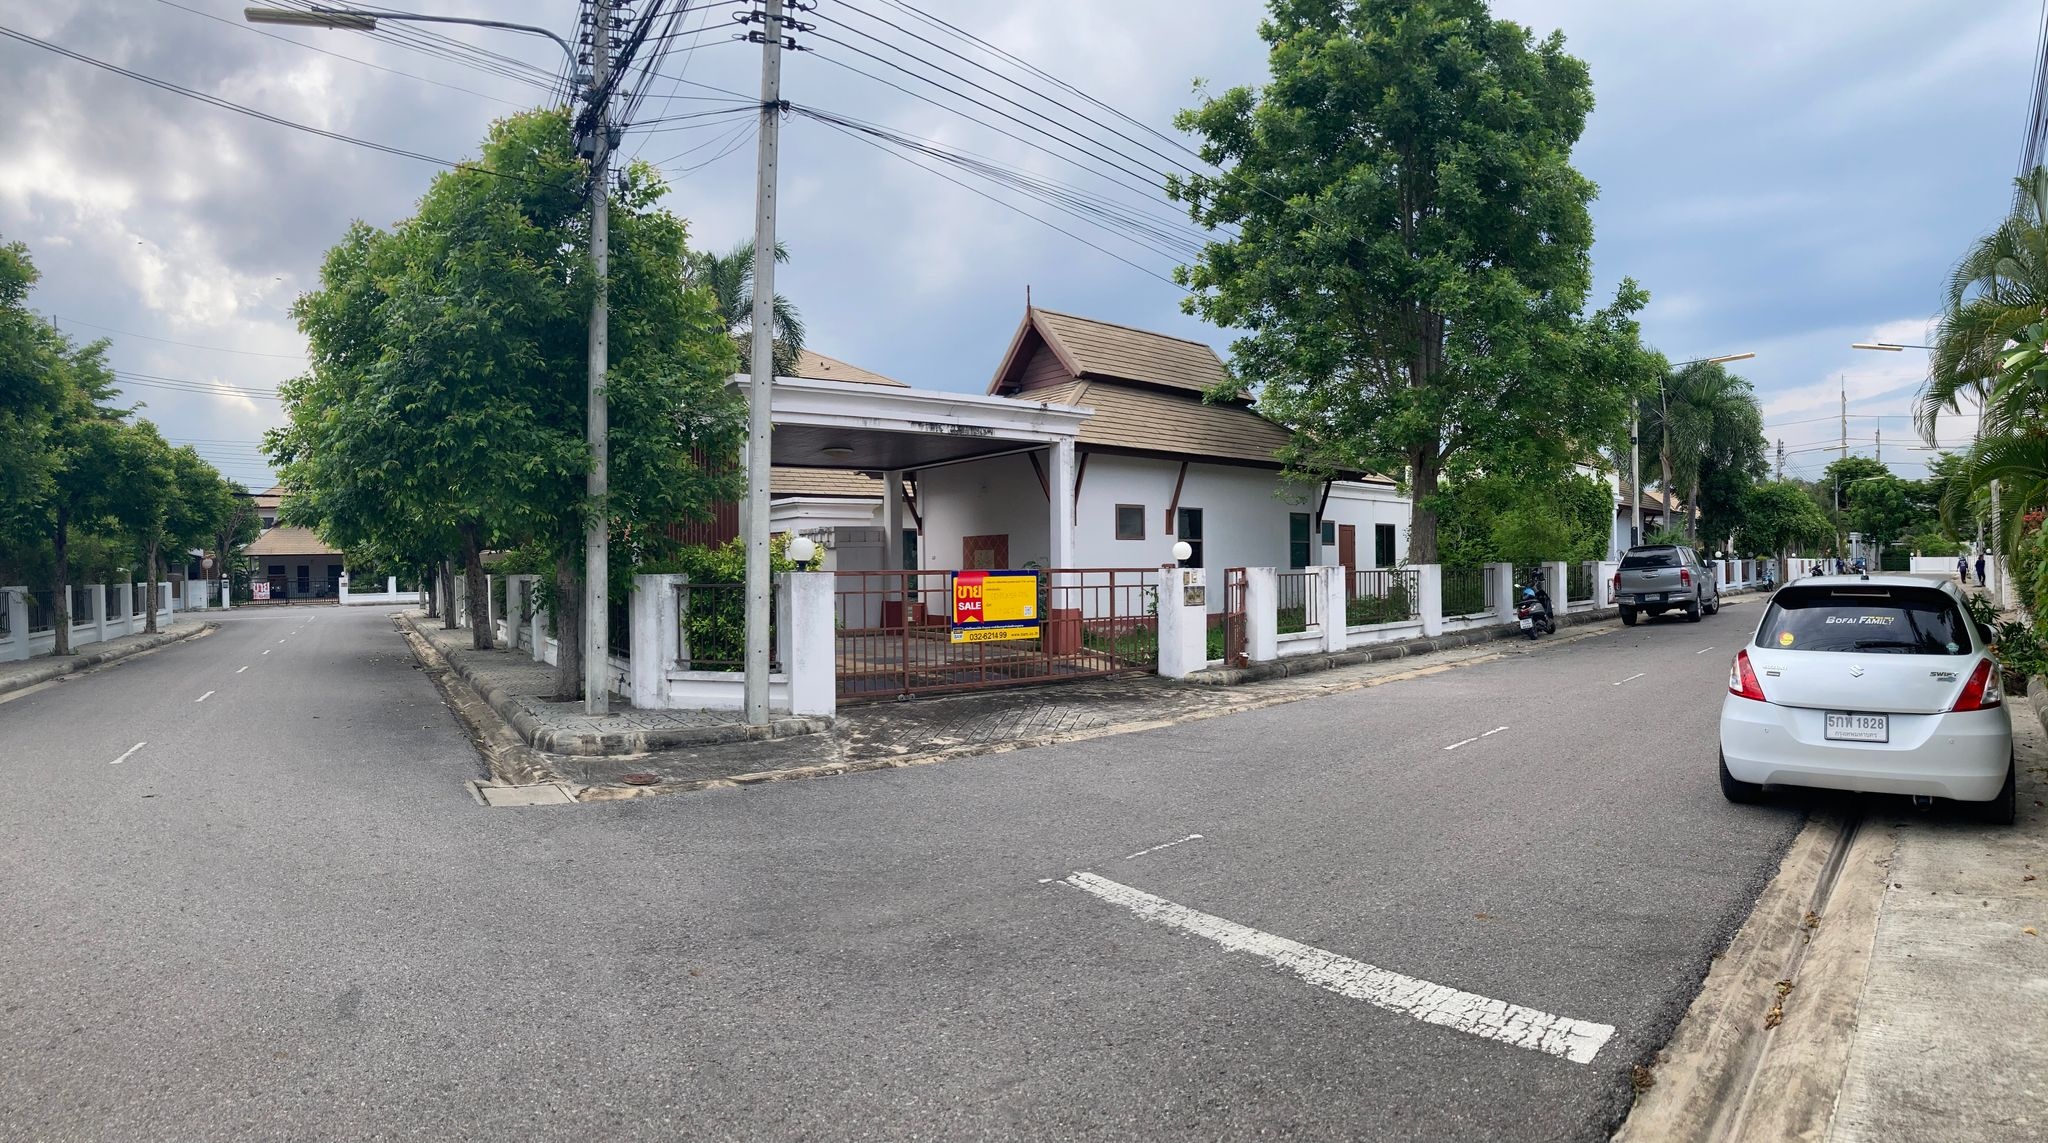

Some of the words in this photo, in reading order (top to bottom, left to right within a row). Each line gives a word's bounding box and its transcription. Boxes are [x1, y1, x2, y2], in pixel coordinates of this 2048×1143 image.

[958, 585, 982, 598] ขาย
[958, 602, 981, 610] SALE
[1856, 717, 1884, 729] 1828
